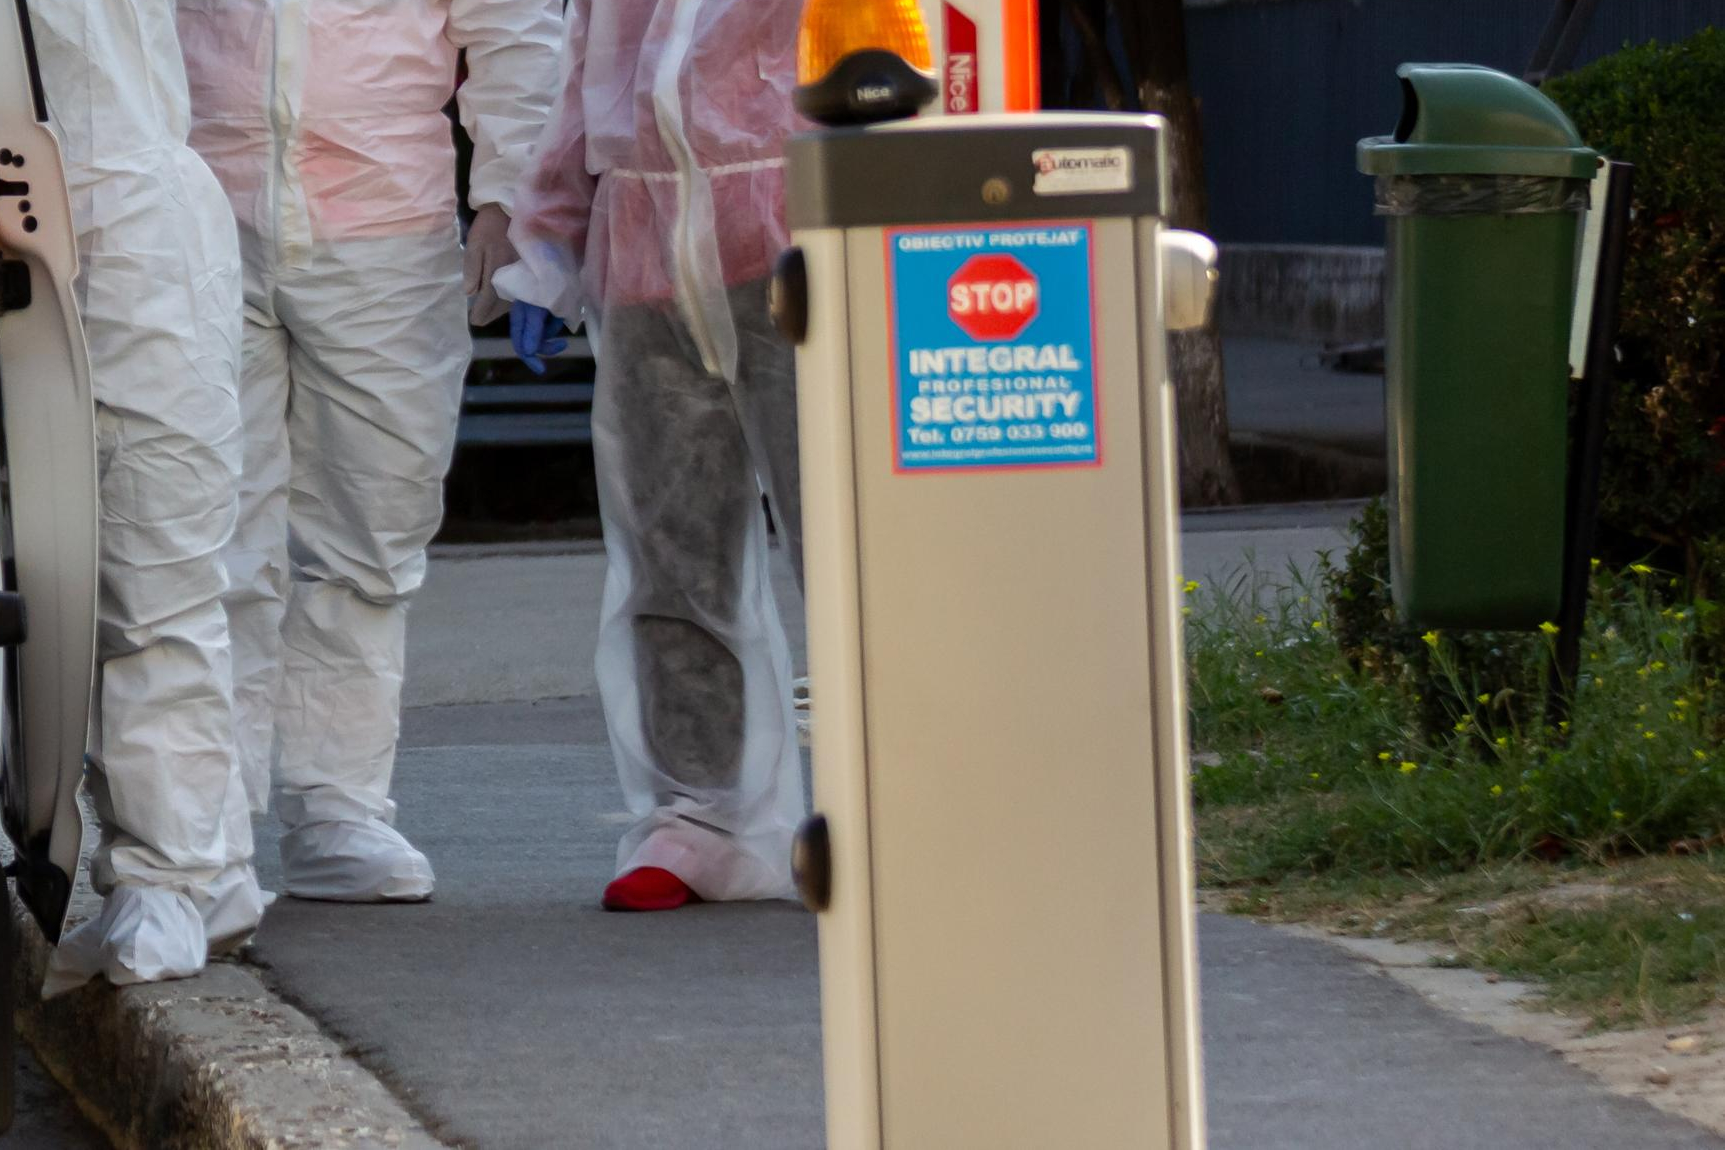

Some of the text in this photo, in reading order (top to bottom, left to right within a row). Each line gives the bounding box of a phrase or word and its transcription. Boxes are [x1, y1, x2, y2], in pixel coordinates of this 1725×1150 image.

[856, 86, 891, 100] Nice
[949, 54, 971, 111] Nice
[899, 230, 1080, 252] OBIECTIV PROTEJAT
[951, 282, 1035, 313] STOP
[909, 345, 1080, 375] INTEGRAL
[918, 376, 1072, 394] PROFESIONAL
[910, 391, 1082, 423] SECURITY
[908, 428, 944, 444] Tel.
